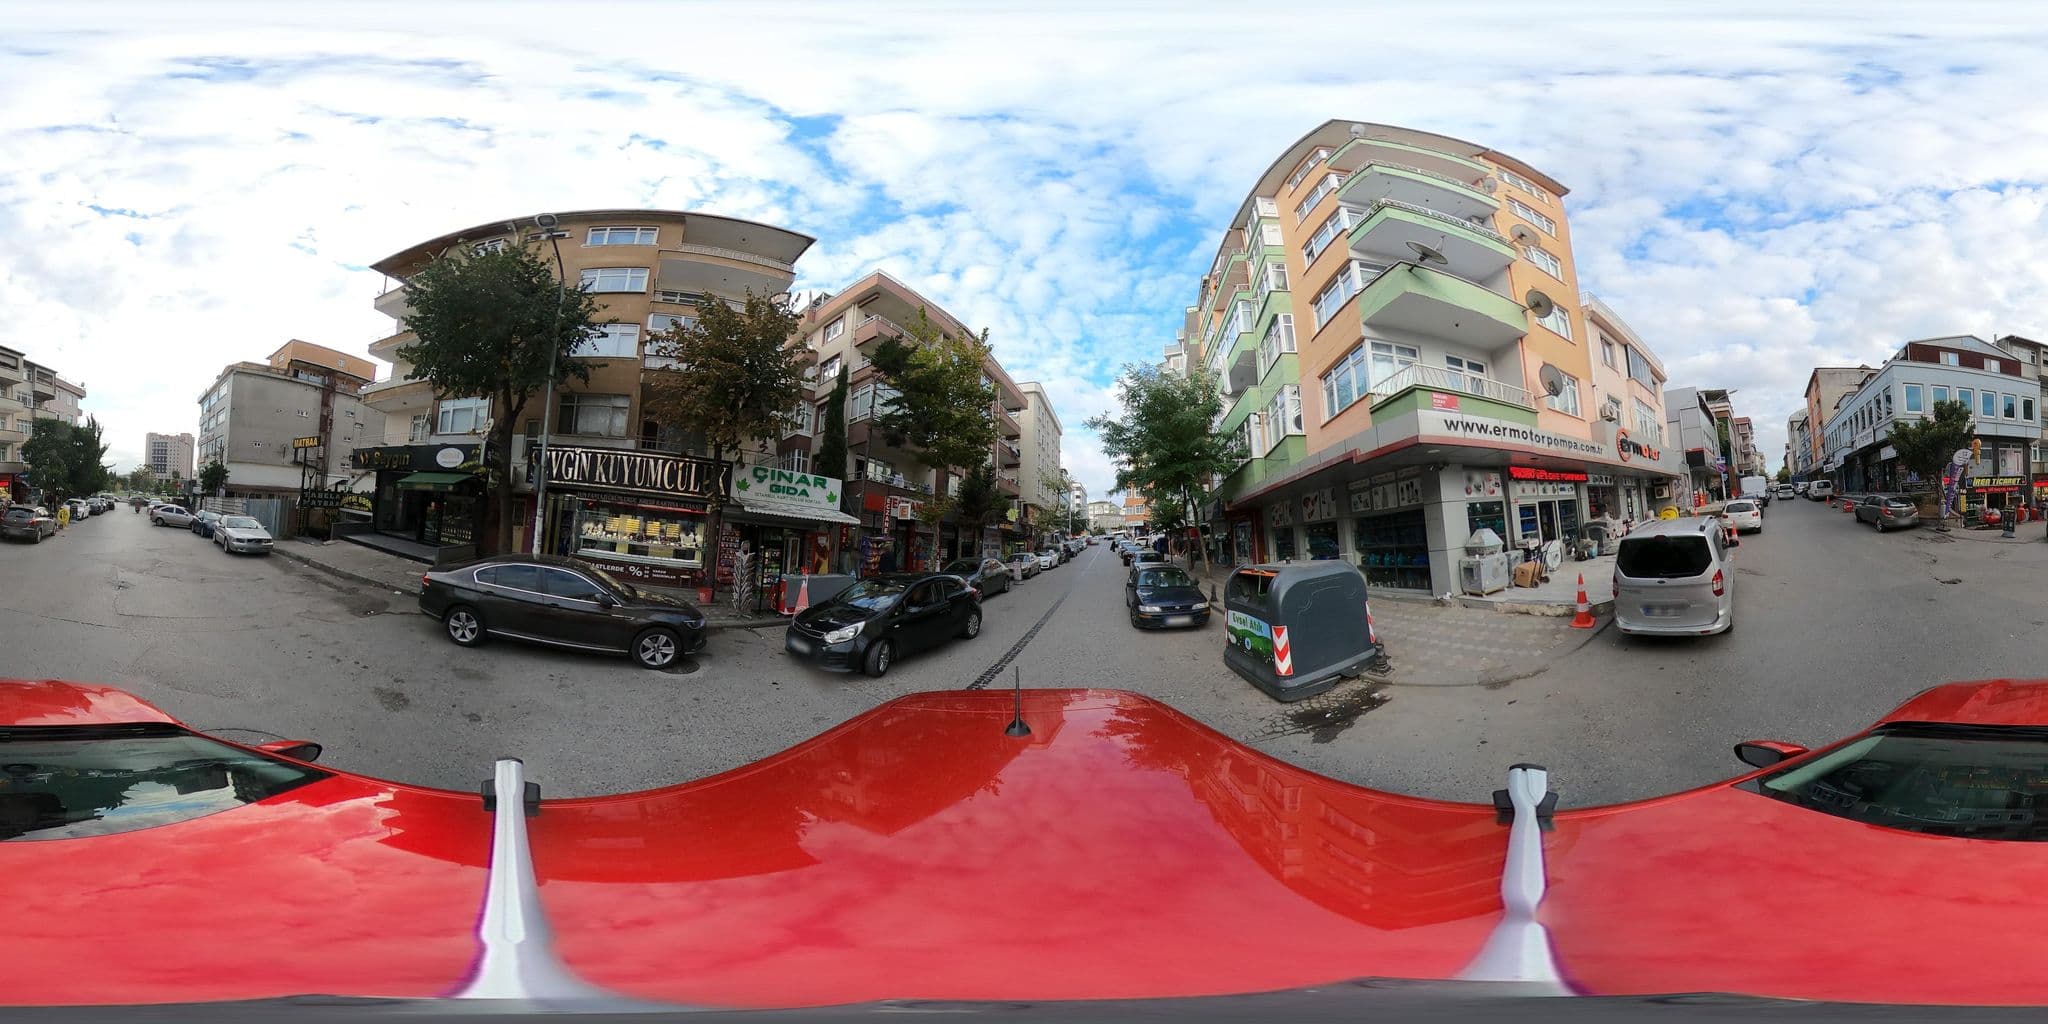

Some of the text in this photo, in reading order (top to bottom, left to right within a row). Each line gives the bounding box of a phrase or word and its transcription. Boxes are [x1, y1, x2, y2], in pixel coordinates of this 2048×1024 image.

[1444, 418, 1603, 455] www.ermotorpompa.com.tr
[532, 448, 727, 496] VGİN KUYUMCUL
[753, 466, 828, 490] ÇINAR
[769, 484, 810, 498] GIDA
[1232, 612, 1248, 627] Evsel
